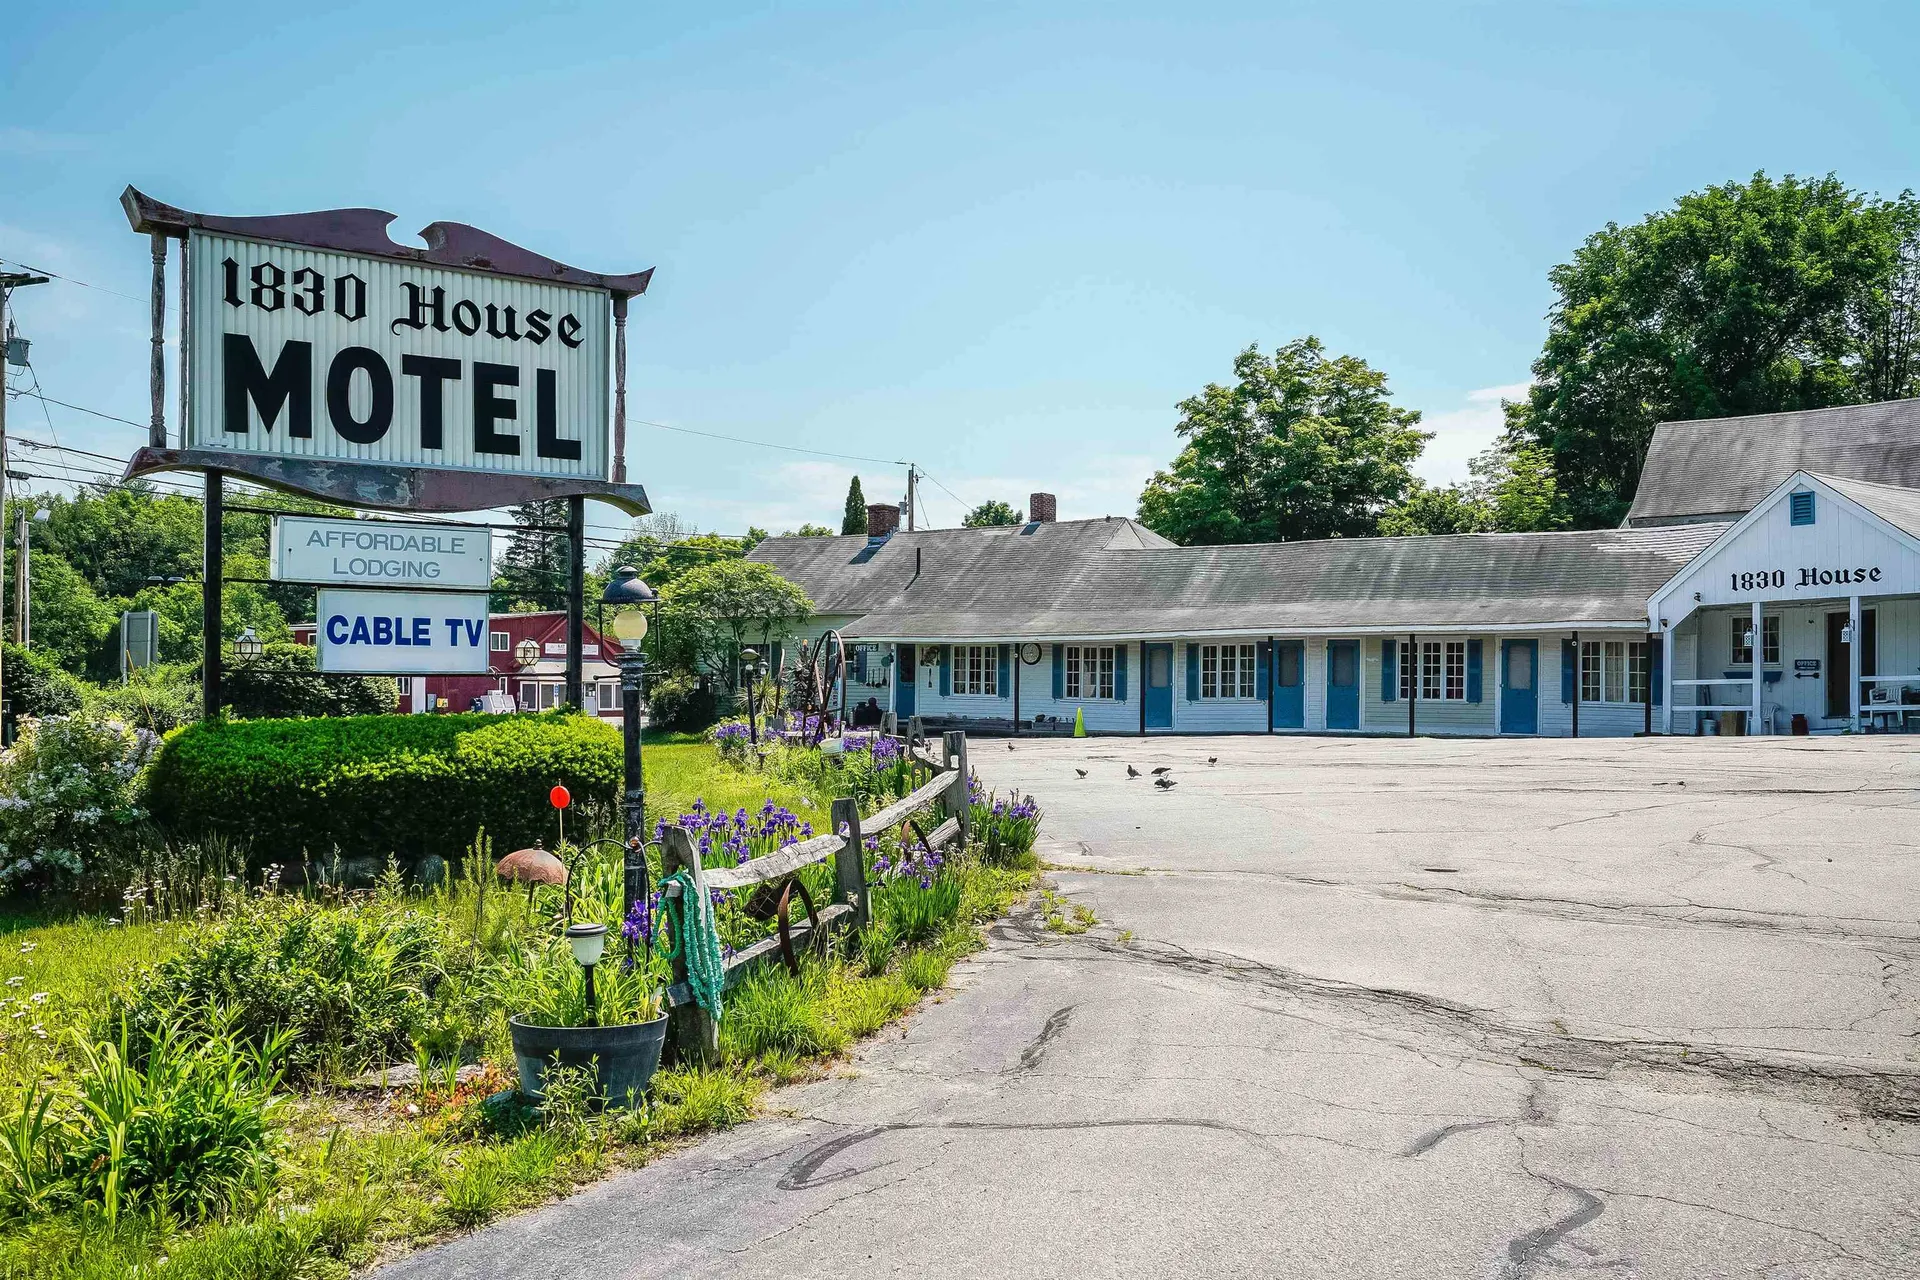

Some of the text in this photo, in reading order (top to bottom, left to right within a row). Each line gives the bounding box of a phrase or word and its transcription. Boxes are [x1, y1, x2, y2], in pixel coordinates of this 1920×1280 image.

[221, 256, 585, 349] 1830 House
[222, 333, 582, 462] MOTEL
[306, 529, 466, 555] AFFORDABLE
[333, 557, 441, 579] LODGING
[1731, 566, 1883, 592] 1830 House
[326, 614, 485, 647] CABLE TV
